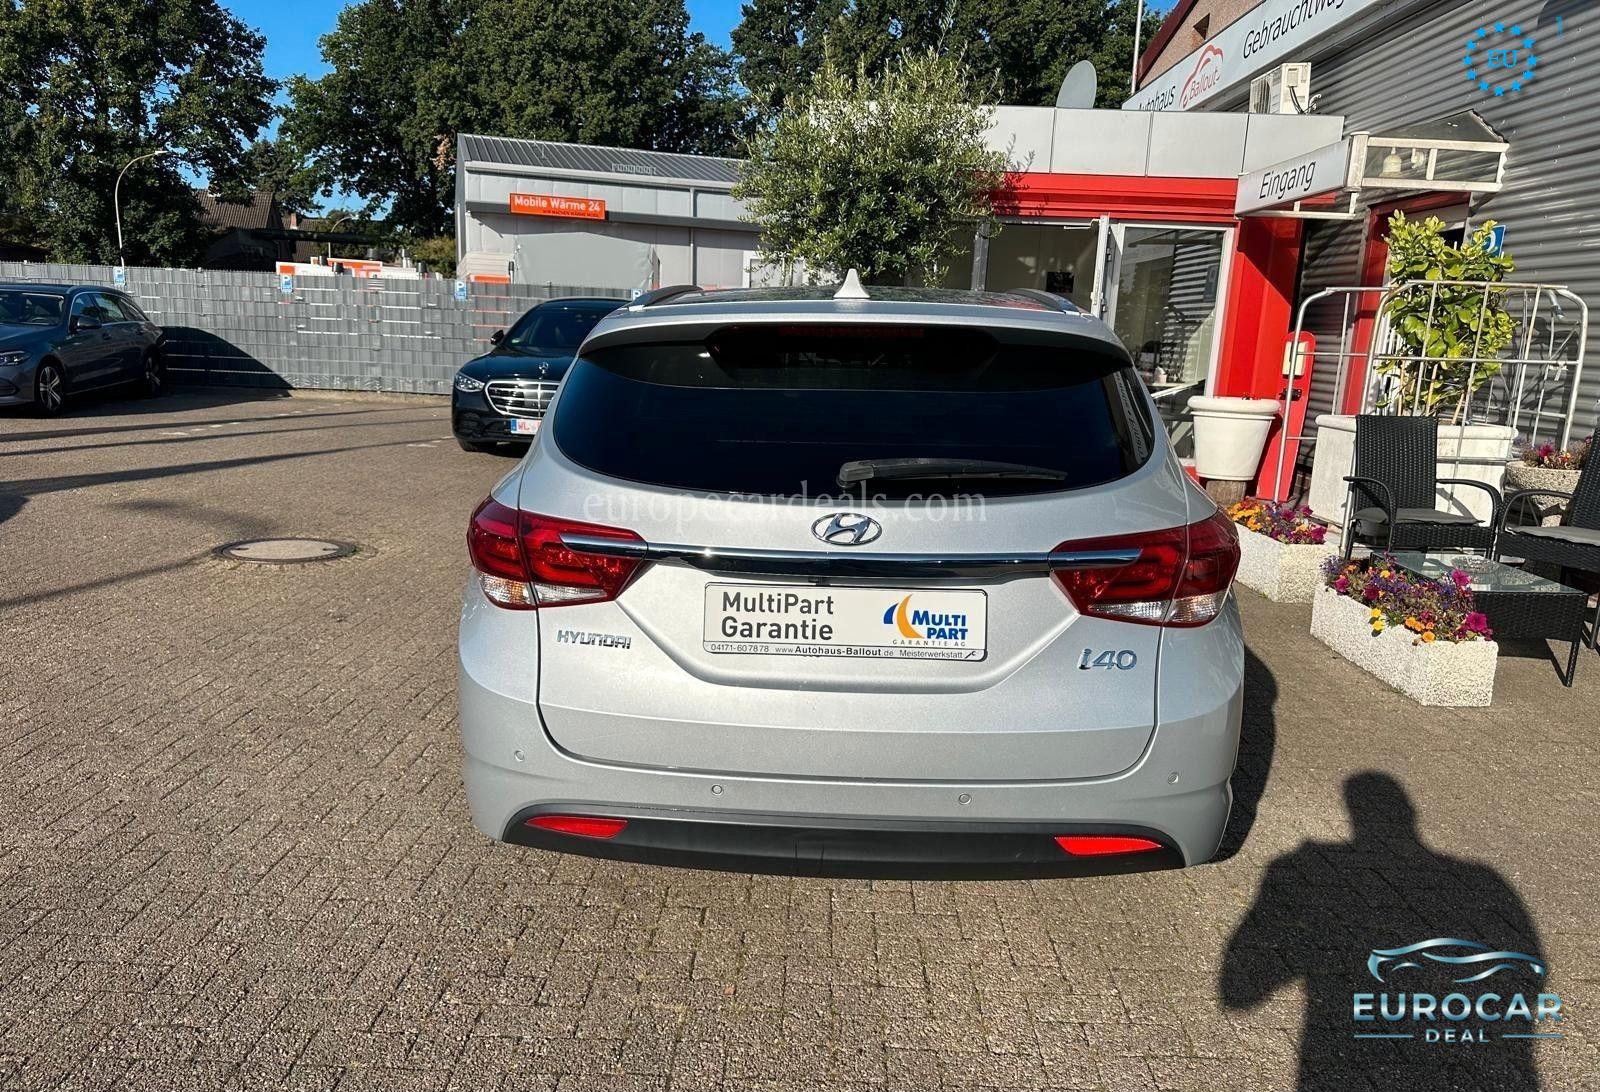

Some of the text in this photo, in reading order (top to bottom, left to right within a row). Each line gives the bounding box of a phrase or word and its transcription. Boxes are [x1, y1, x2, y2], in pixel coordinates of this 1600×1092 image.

[1259, 161, 1317, 200] Eingang
[514, 196, 601, 211] Mobile Wärme 24
[722, 591, 834, 615] MultiPart
[911, 609, 966, 626] MULTI
[721, 615, 834, 640] Garantie
[926, 627, 968, 640] PART
[556, 629, 632, 649] HYUNDAI
[892, 639, 948, 647] GARANTIE
[899, 649, 963, 659] Meisterwerkstatt
[1078, 648, 1138, 670] i40
